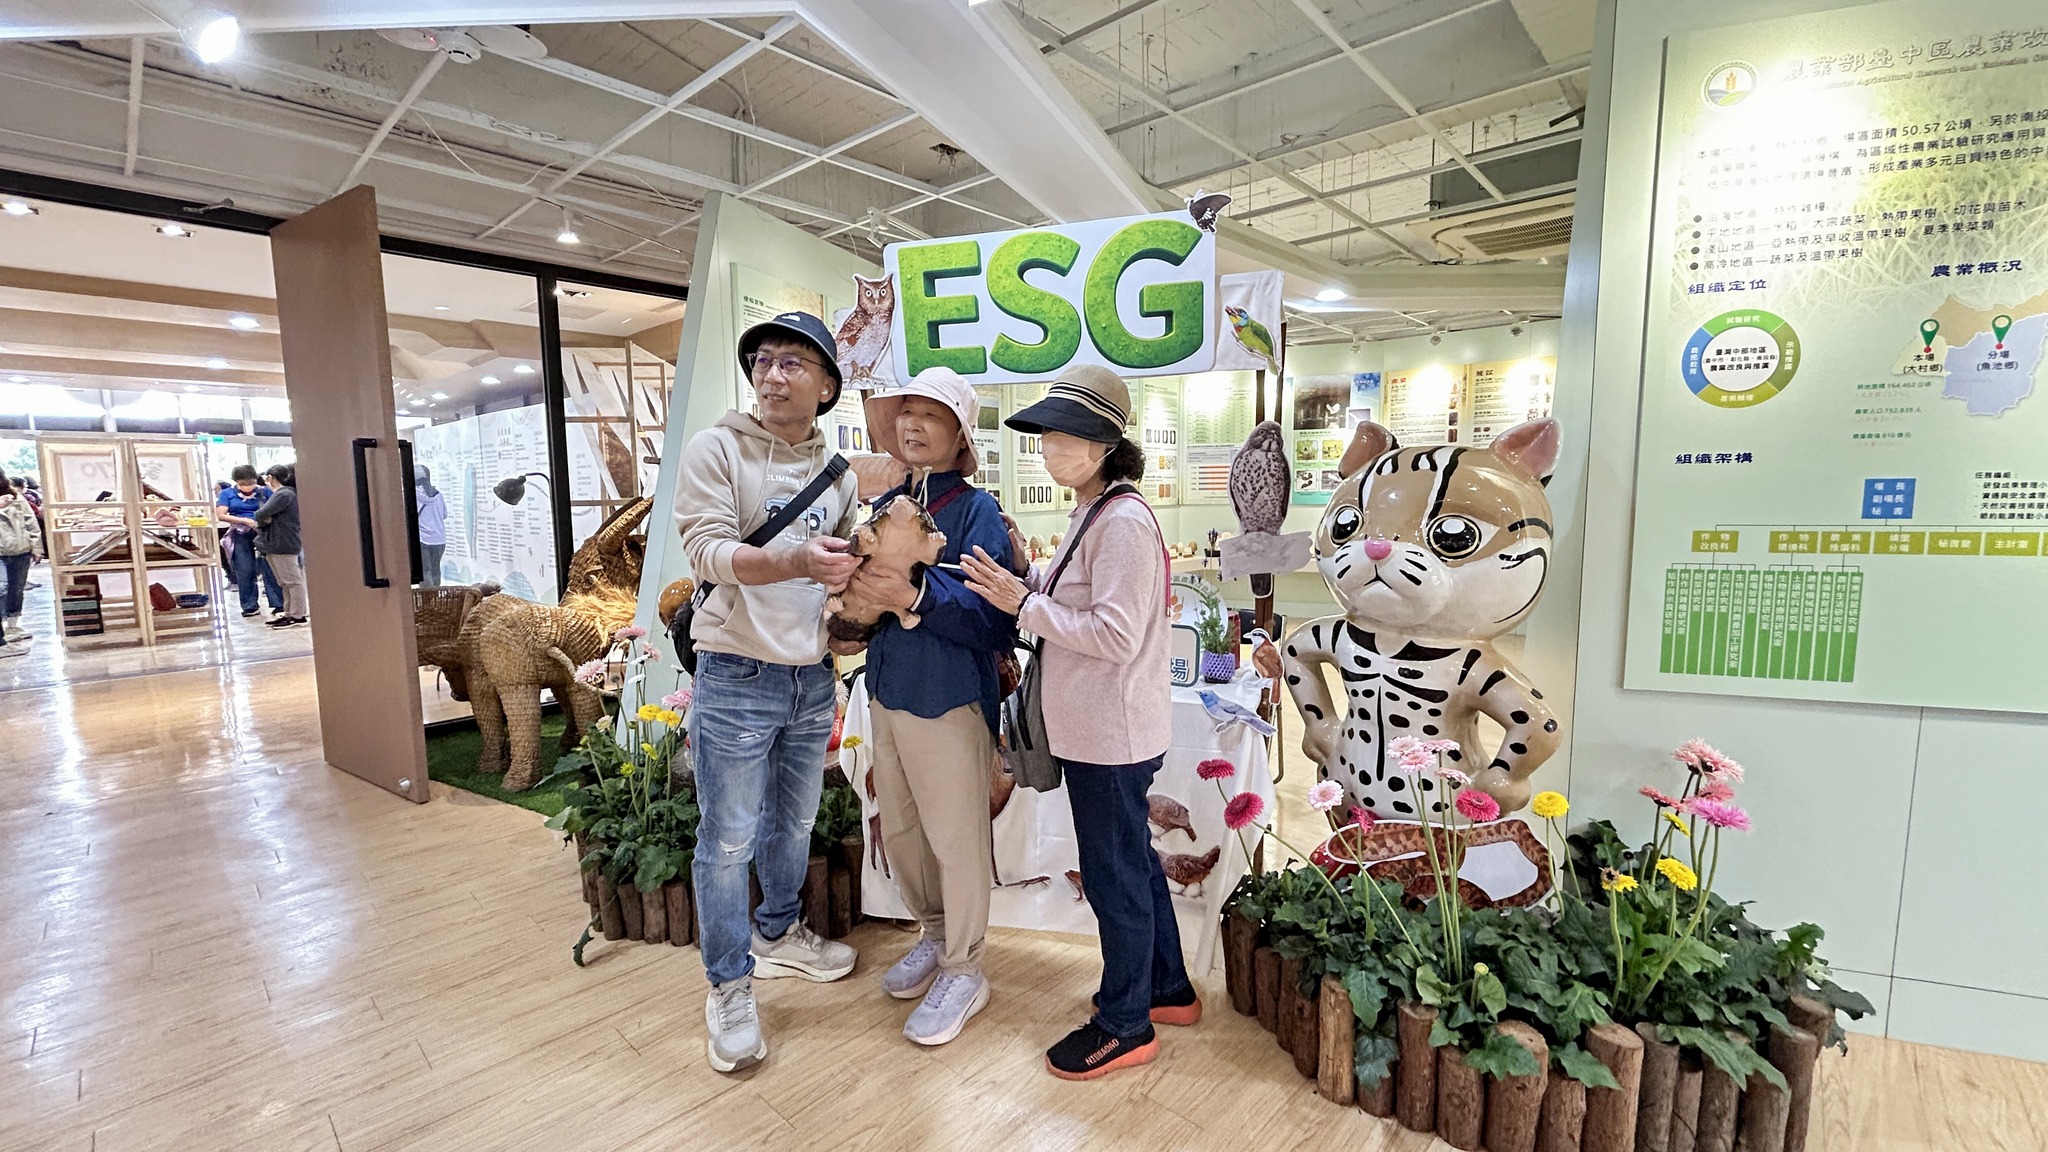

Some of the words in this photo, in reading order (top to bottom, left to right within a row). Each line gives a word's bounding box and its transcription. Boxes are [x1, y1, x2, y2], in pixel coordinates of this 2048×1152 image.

[1901, 122, 1940, 137] 50.57
[1930, 259, 2023, 277] 農業概況
[1687, 279, 1767, 295] 組織定位
[897, 218, 1205, 377] ESG
[1913, 354, 1935, 362] 本場
[1987, 350, 2010, 360] 分場
[1903, 364, 1943, 374] (大村鄉)
[1976, 361, 2019, 373] (魚池鄉)
[1675, 451, 1754, 465] 組織架構
[1170, 657, 1190, 683] 場
